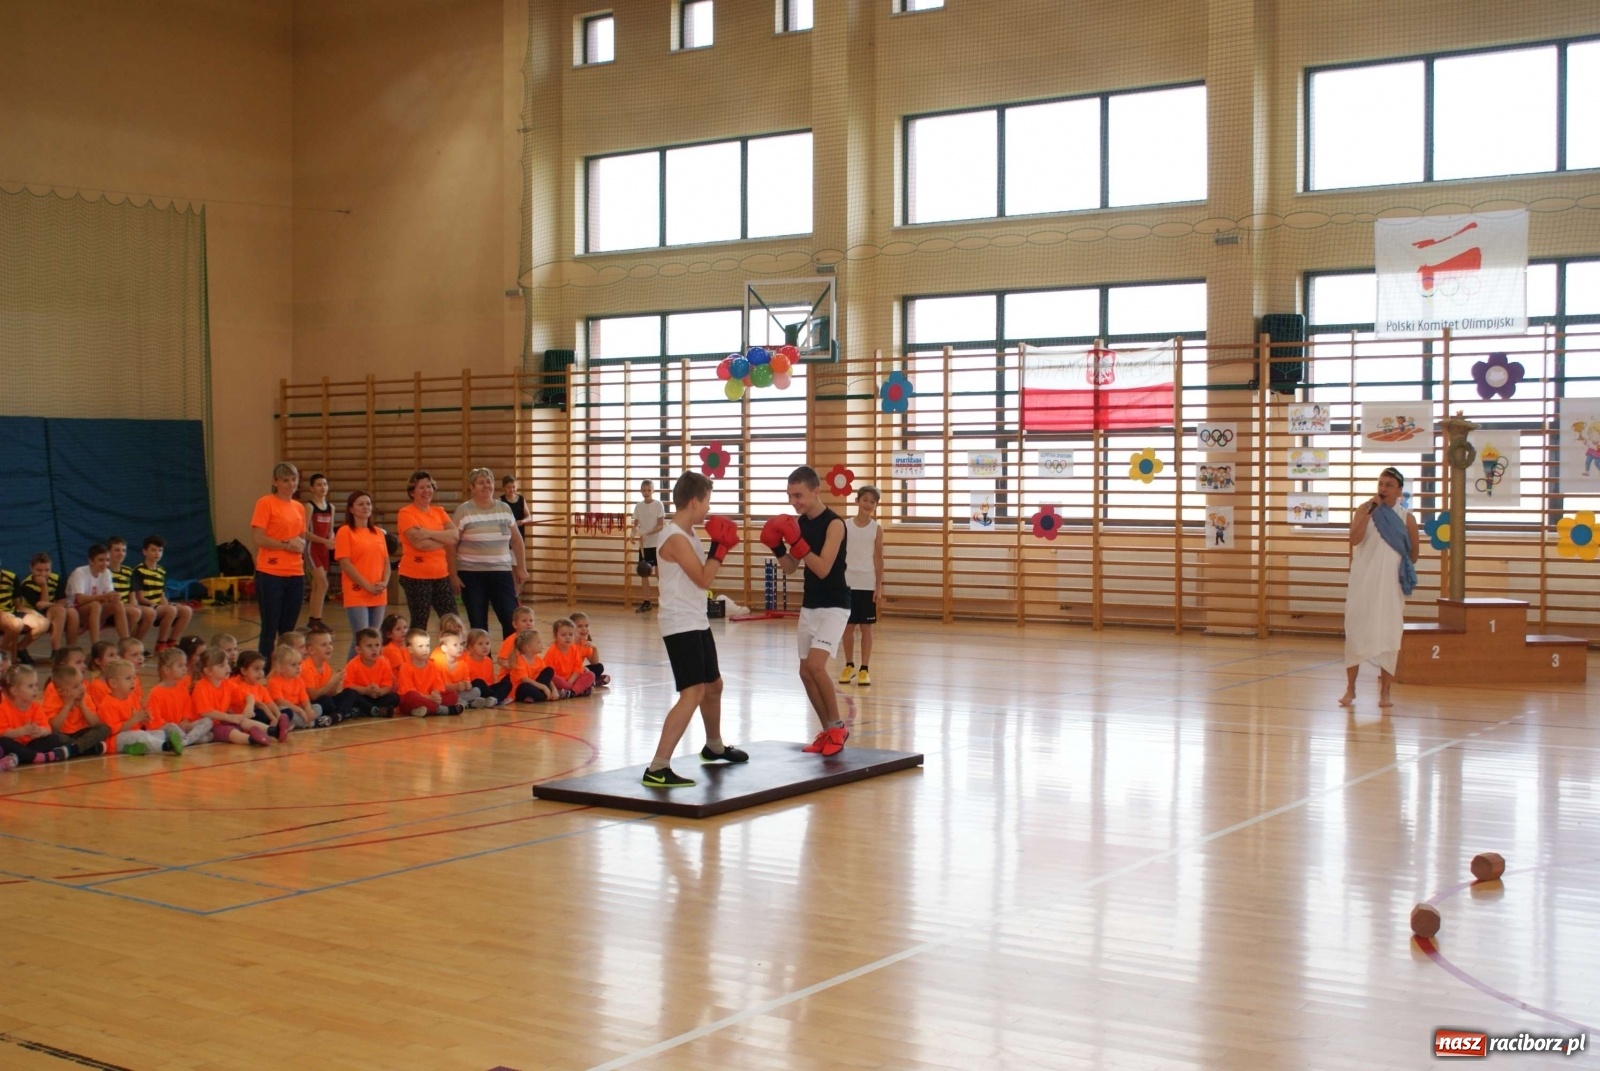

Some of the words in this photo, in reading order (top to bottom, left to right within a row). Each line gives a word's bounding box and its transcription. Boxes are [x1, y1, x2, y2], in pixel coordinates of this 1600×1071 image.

[1386, 320, 1415, 332] Polski
[1418, 319, 1459, 331] Komitet
[1461, 317, 1515, 330] Olimpijski
[1489, 619, 1496, 633] 1
[1431, 645, 1440, 659] 2
[1551, 653, 1560, 668] 3
